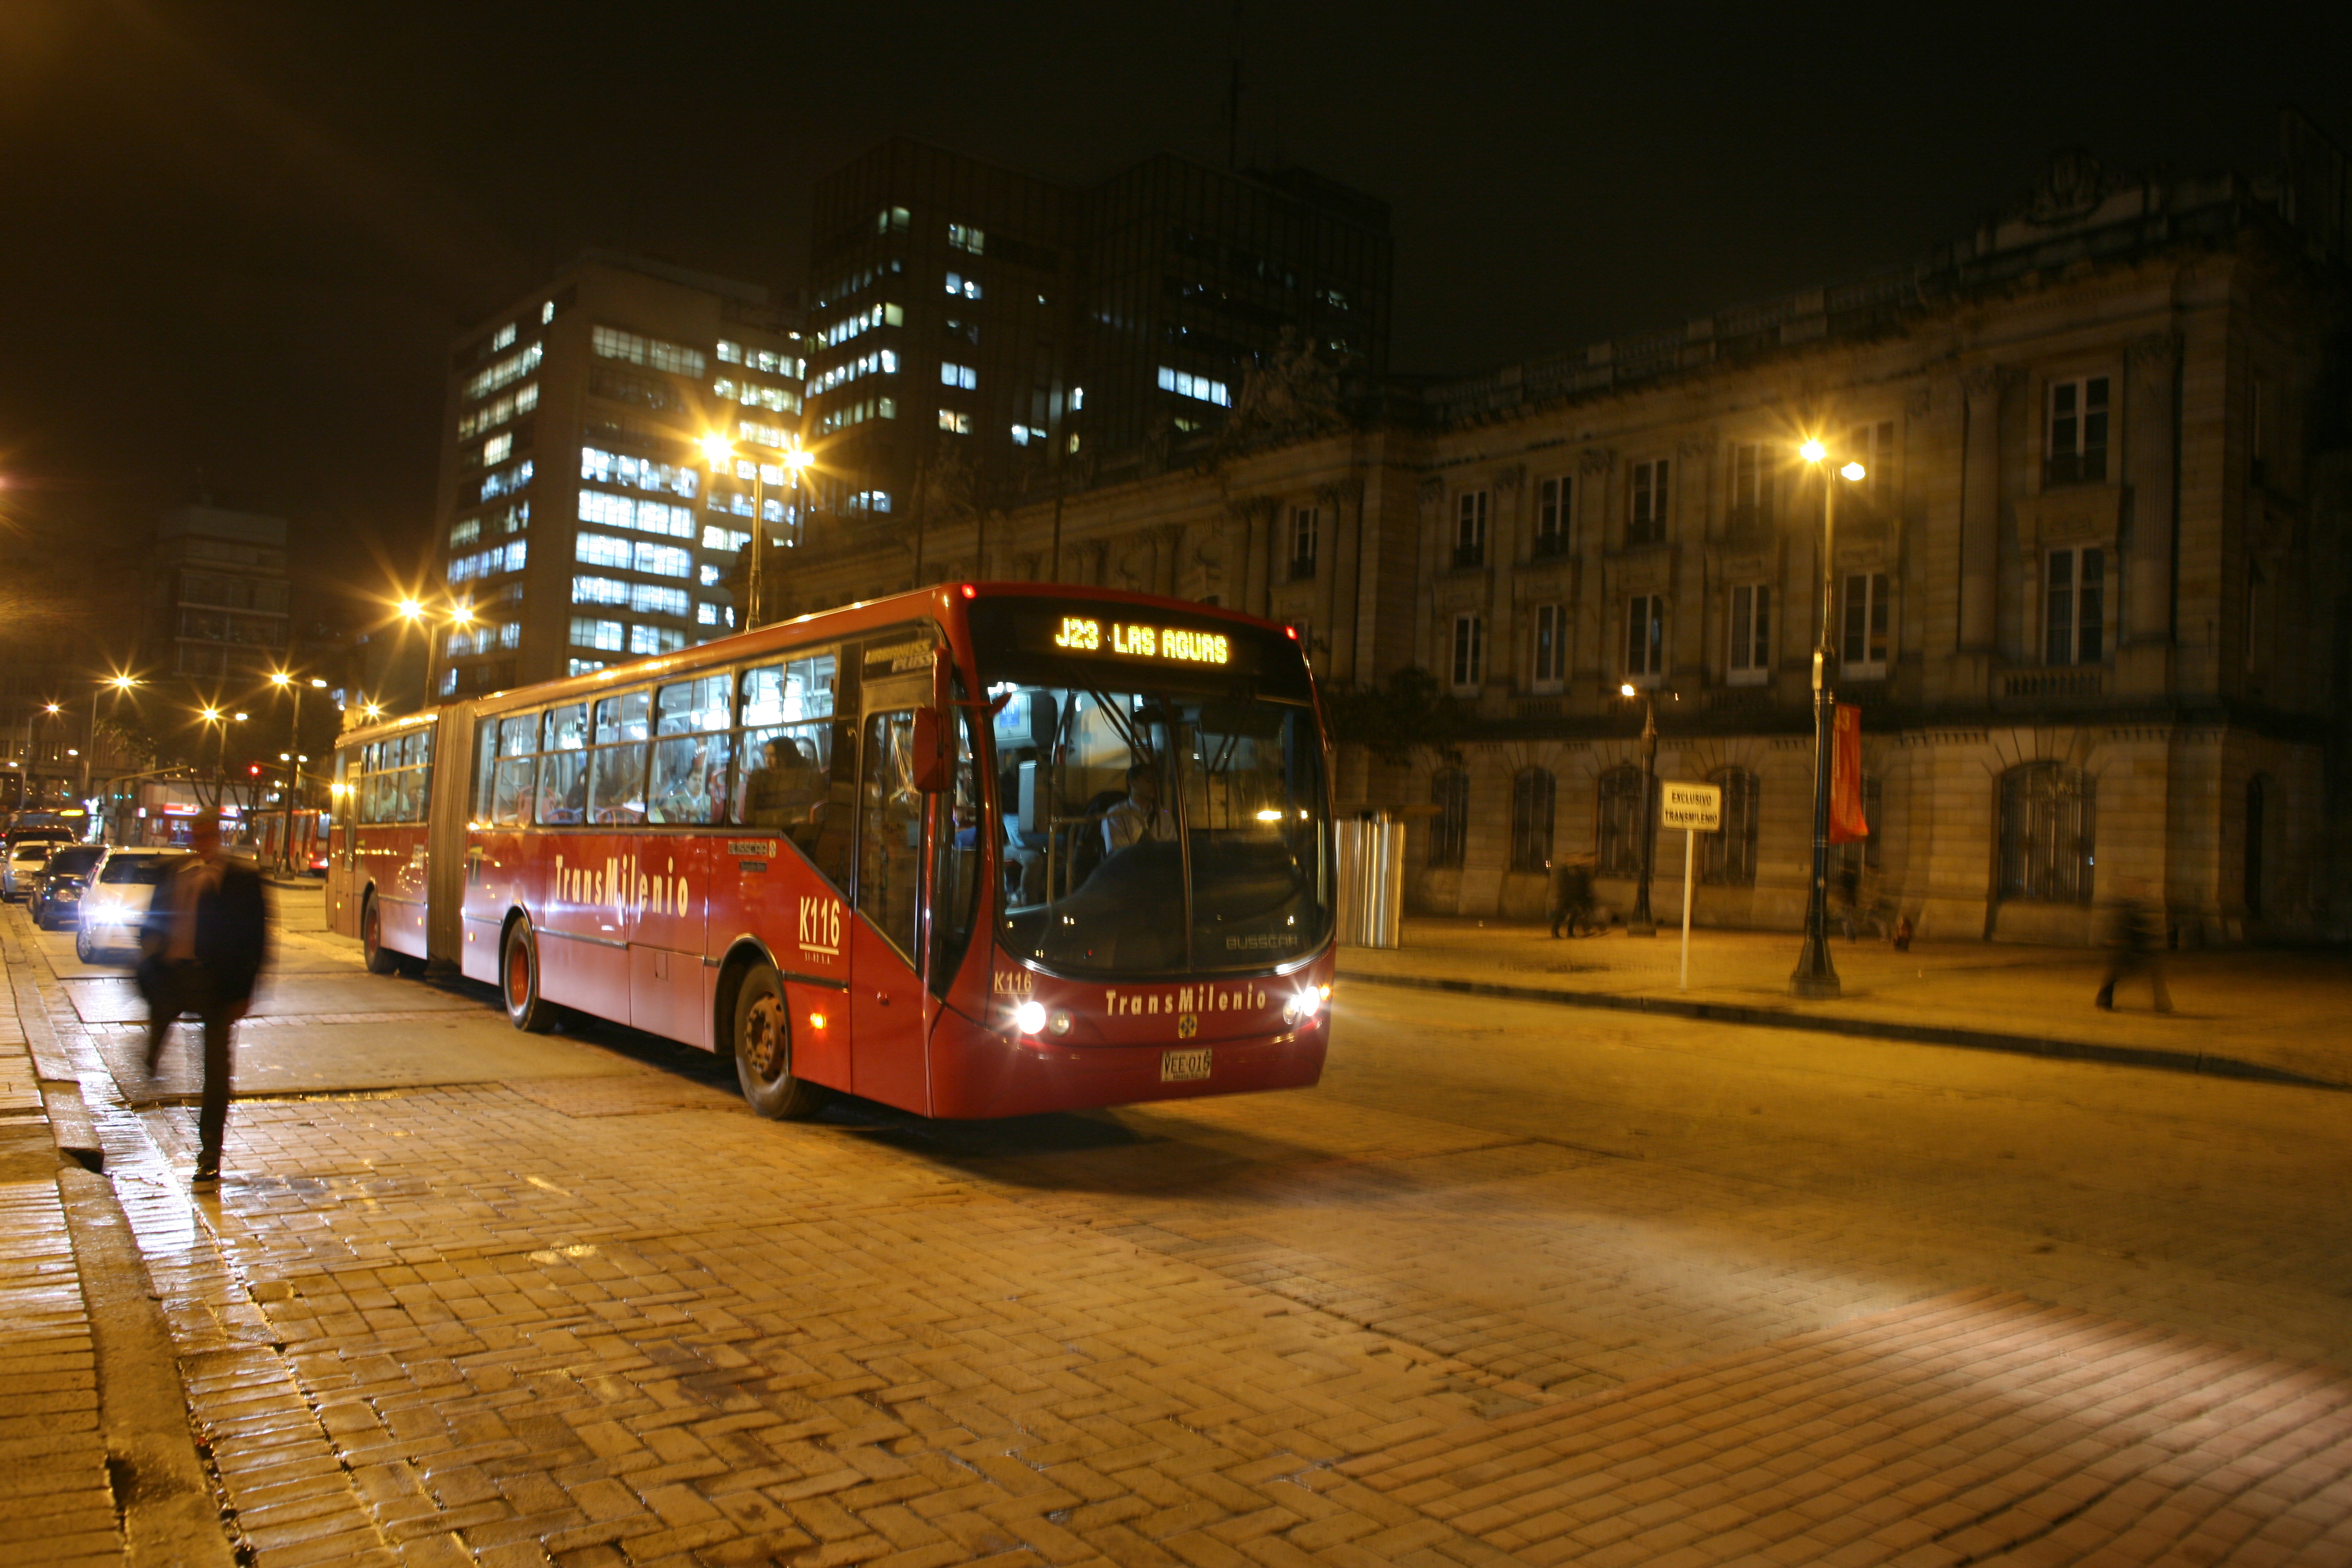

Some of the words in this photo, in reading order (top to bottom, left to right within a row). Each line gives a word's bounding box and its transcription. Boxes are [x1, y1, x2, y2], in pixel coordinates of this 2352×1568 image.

[1055, 617, 1098, 650] J23
[1113, 623, 1156, 656] LAS
[1162, 629, 1228, 664] AGUAS
[1671, 790, 1712, 806] EXCLUSIVO
[1665, 809, 1717, 825] TRANSMILENIO
[556, 853, 688, 918] TransMilenio
[799, 895, 840, 947] K116
[994, 970, 1032, 992] K116
[1106, 982, 1265, 1016] TransMilenio
